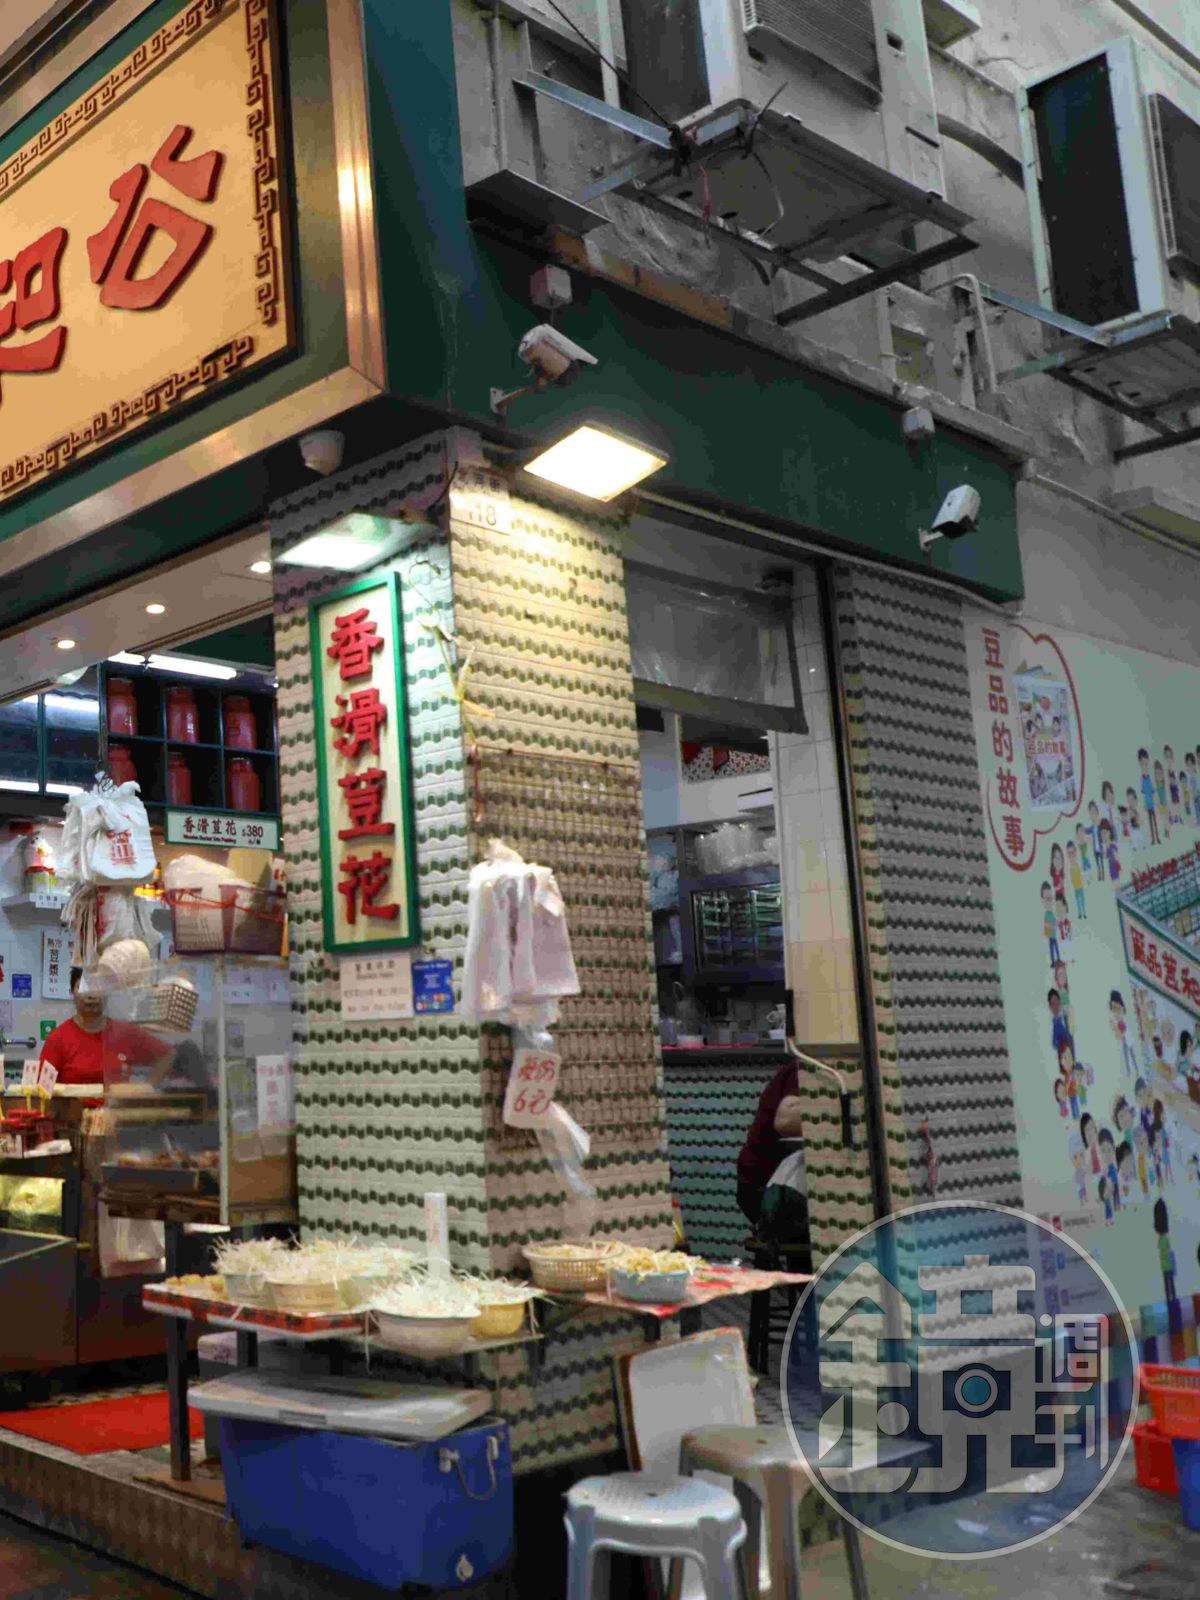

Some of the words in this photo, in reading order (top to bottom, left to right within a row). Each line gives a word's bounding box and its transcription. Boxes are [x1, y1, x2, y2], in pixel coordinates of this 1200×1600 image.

[241, 824, 264, 838] $380
[325, 607, 400, 926] 香滑荳花
